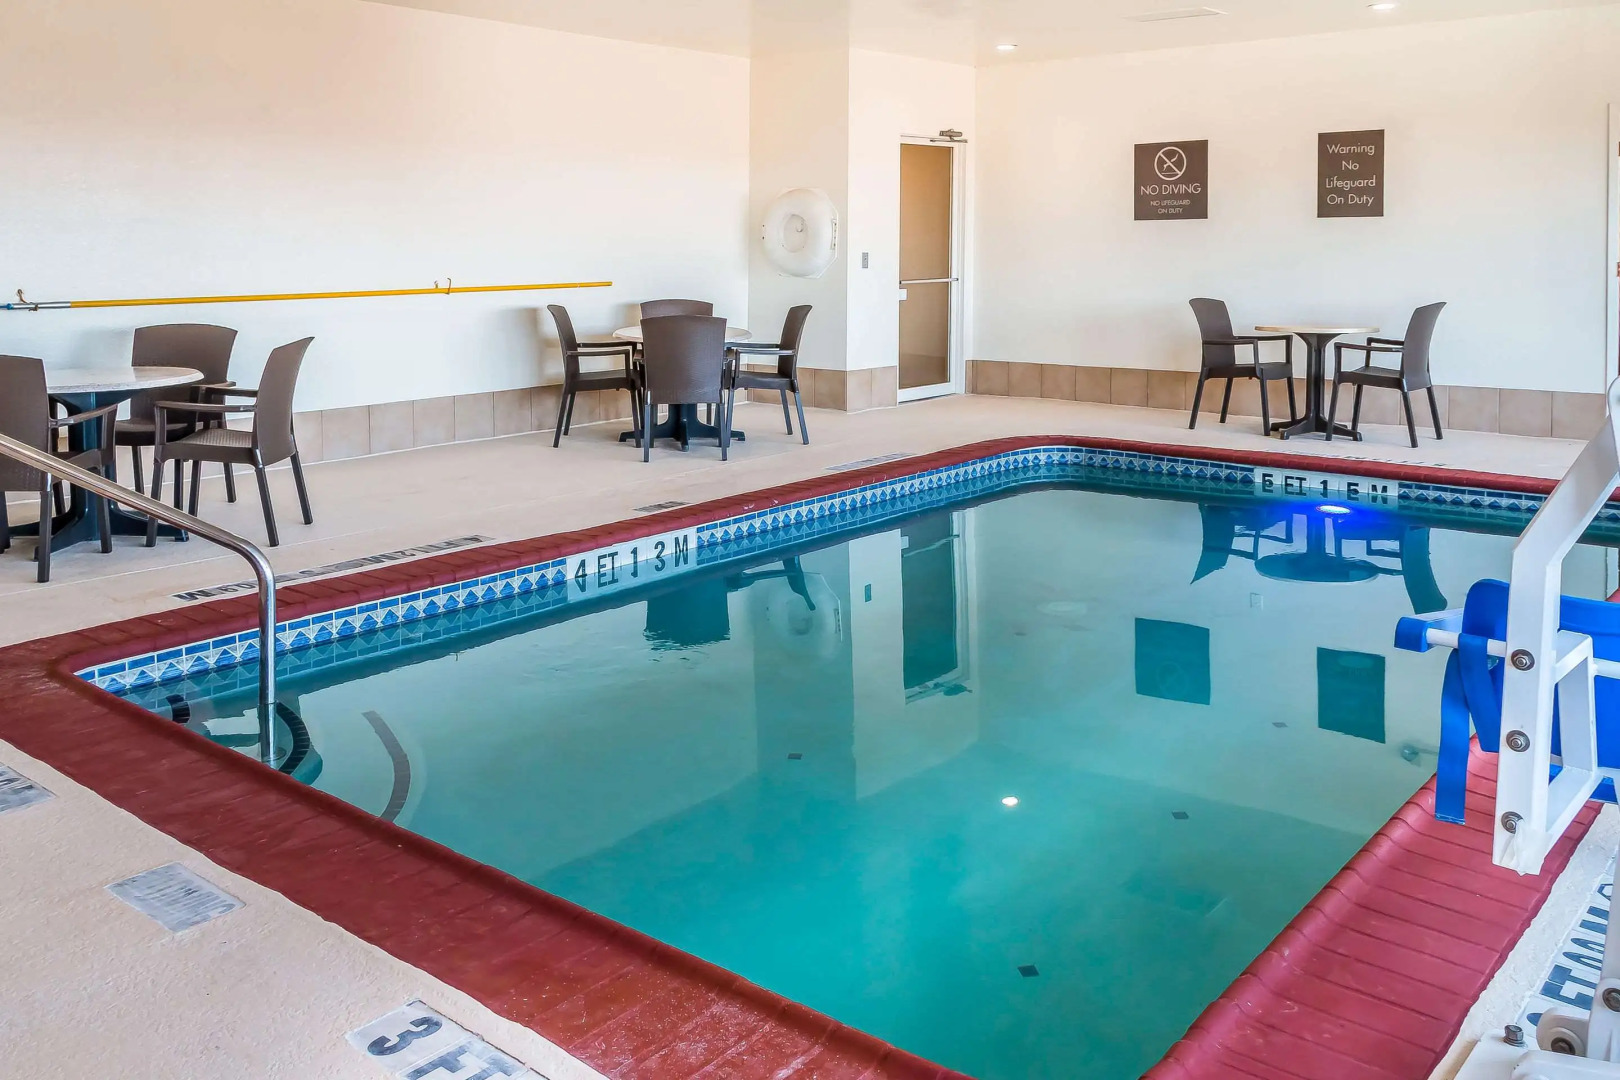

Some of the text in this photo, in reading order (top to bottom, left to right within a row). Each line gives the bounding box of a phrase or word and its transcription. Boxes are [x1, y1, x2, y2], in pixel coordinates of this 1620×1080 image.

[1326, 142, 1375, 156] Warning
[1341, 160, 1360, 171] No
[1140, 183, 1202, 196] NO DIVING
[1325, 174, 1376, 191] Lifeguard
[1326, 193, 1375, 207] On Duty
[366, 1016, 443, 1056] 3
